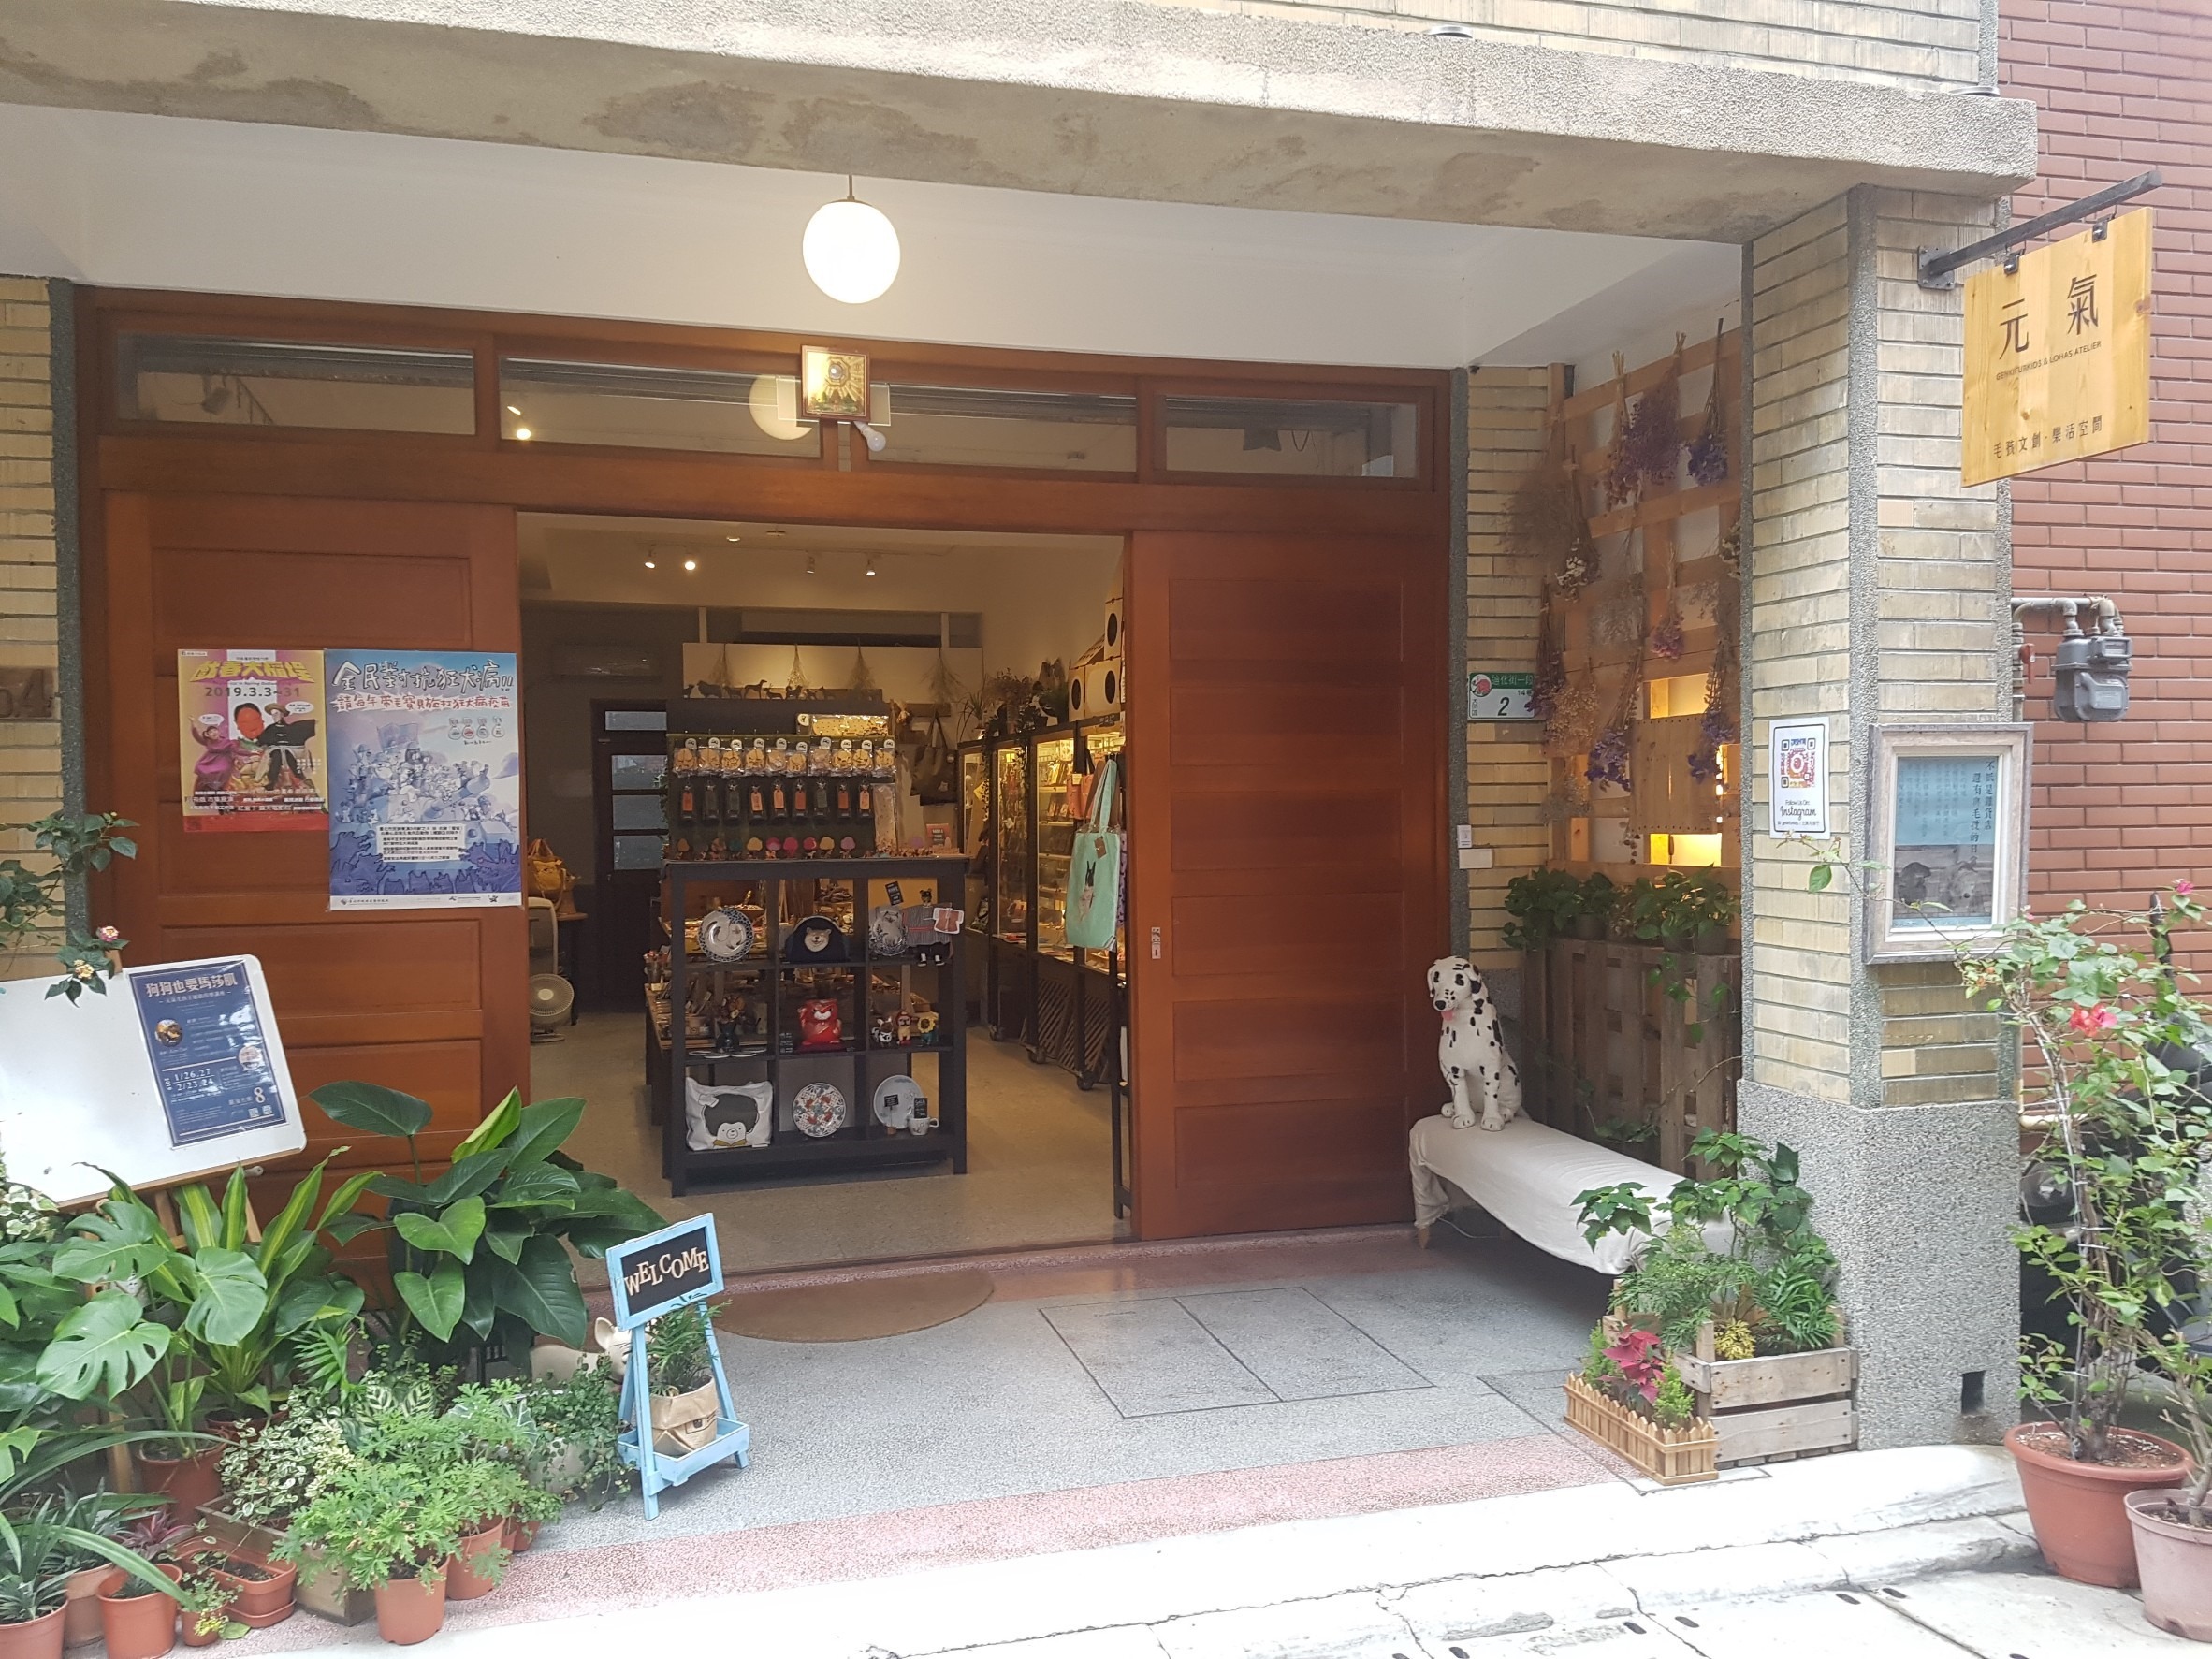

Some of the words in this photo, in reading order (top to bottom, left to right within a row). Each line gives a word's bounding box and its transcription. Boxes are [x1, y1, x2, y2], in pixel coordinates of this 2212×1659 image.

[1999, 273, 2099, 360] 元氣
[2074, 340, 2102, 357] ATELIER
[1497, 696, 1510, 716] 2
[1780, 805, 1817, 821] Instagram
[254, 1086, 266, 1103] 8
[624, 1247, 709, 1296] WELCOME
